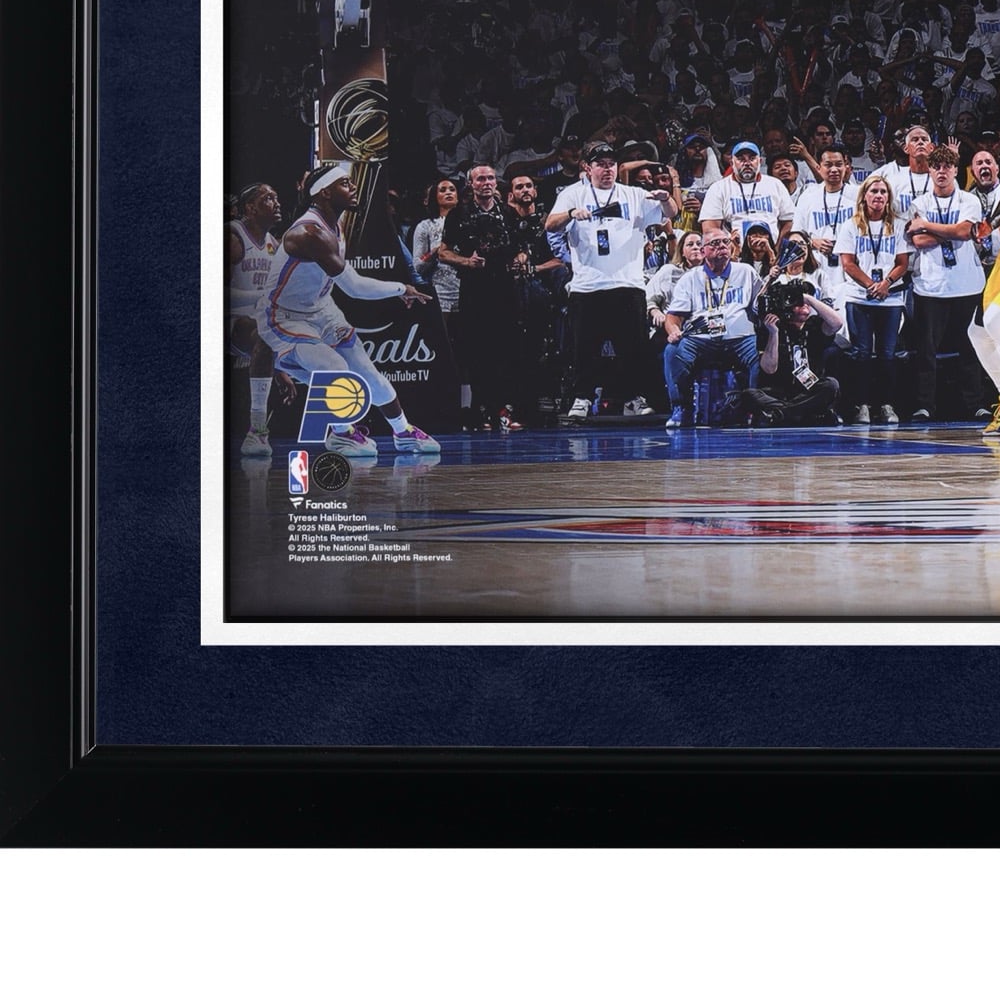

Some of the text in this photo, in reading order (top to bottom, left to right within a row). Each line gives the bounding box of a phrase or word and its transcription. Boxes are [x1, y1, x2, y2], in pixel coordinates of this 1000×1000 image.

[382, 256, 396, 269] TV
[362, 323, 436, 364] nals
[418, 369, 430, 381] TV
